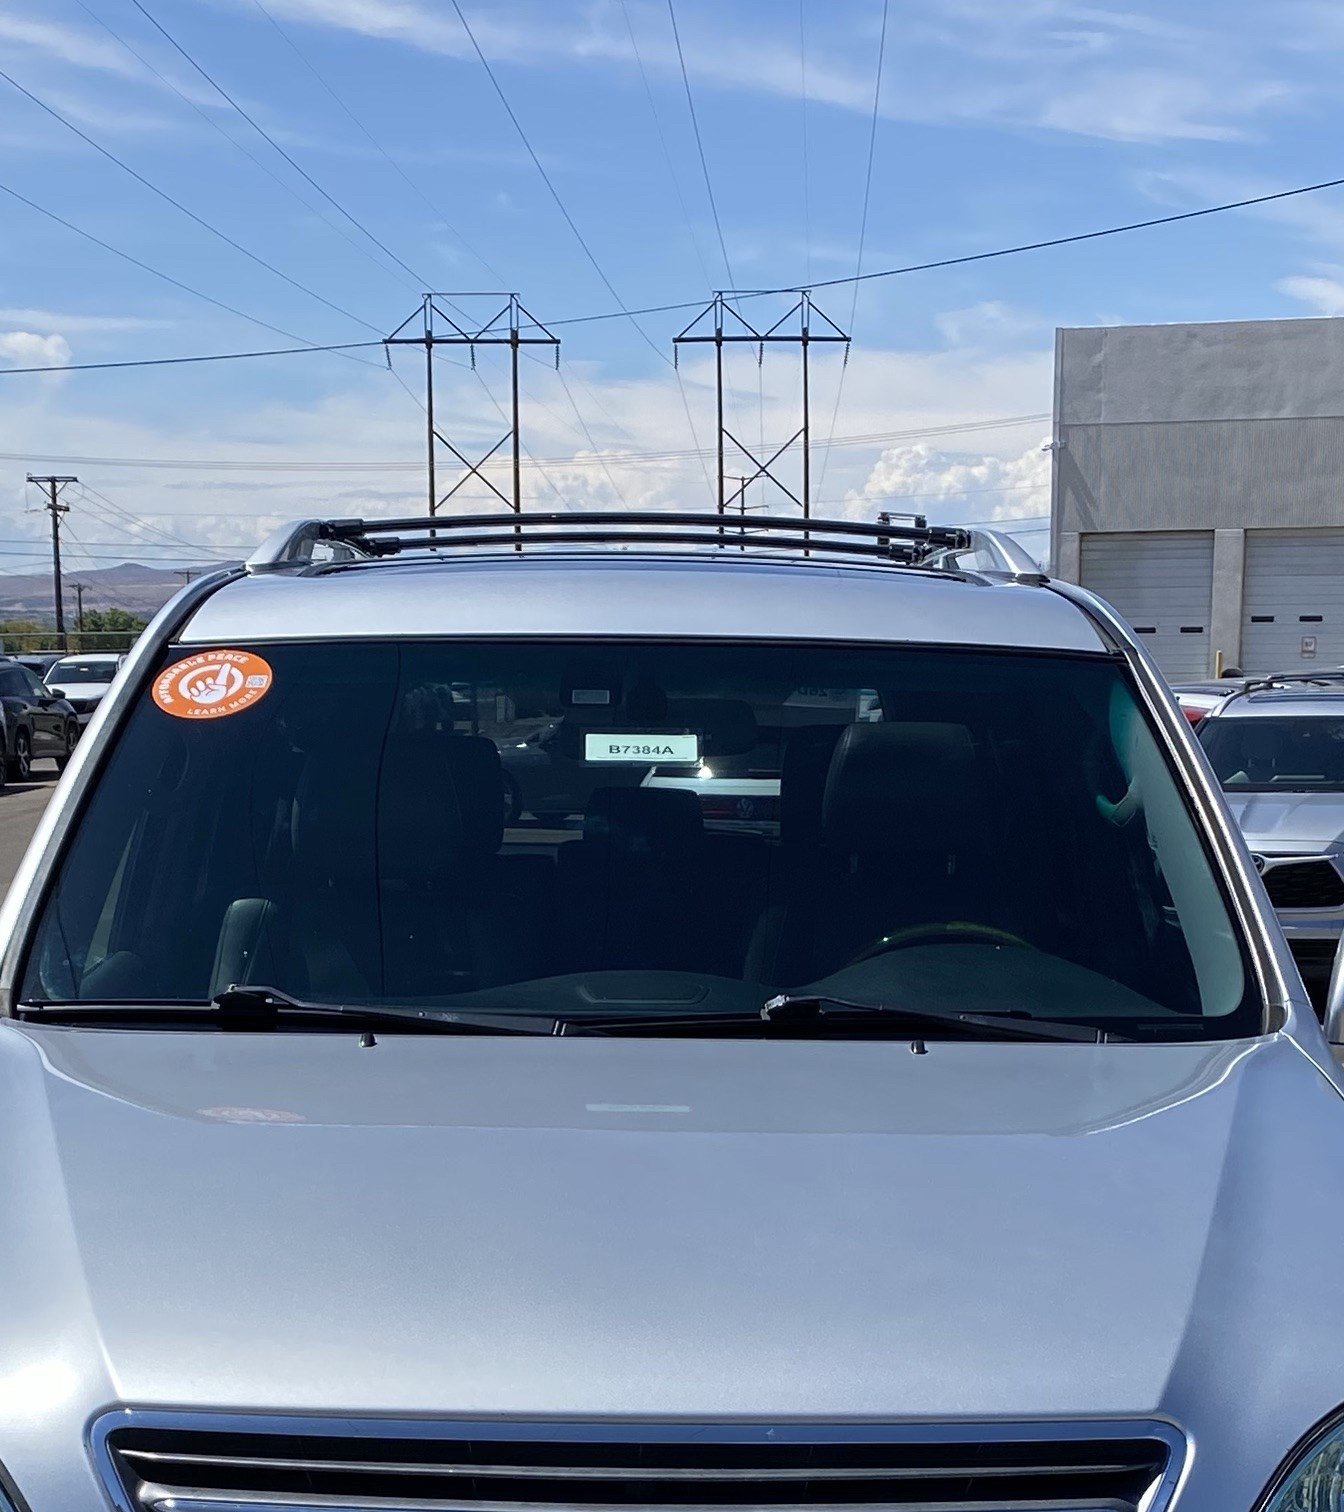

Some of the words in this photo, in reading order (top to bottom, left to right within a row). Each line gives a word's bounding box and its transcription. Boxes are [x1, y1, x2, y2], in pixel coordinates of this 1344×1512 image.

[187, 705, 227, 715] LEARN
[228, 689, 258, 709] MORE
[608, 745, 674, 755] B7384A
